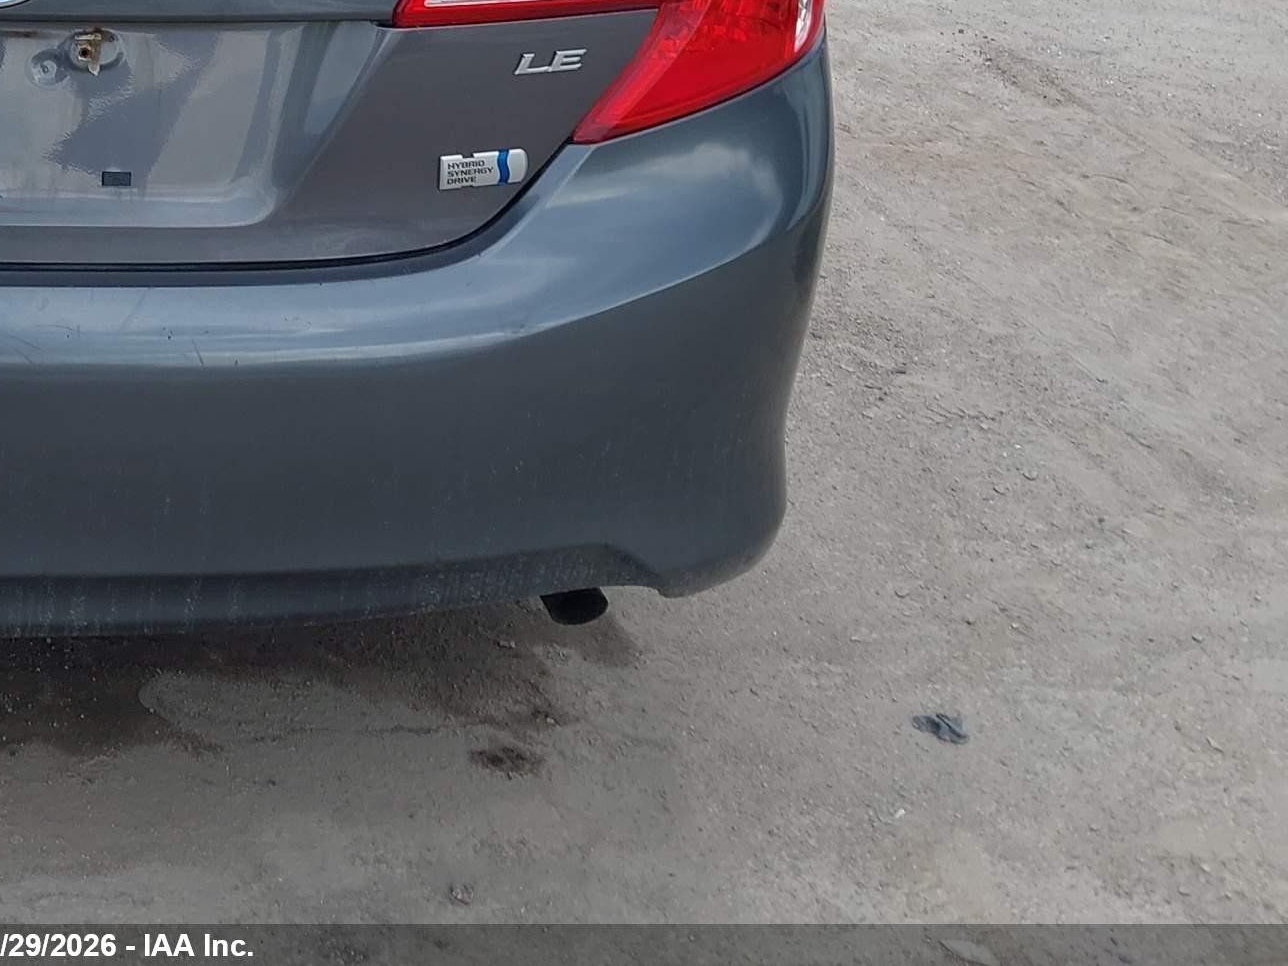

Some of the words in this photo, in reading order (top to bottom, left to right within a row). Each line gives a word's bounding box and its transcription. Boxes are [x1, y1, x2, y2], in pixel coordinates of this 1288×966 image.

[514, 48, 587, 76] LE
[447, 160, 485, 170] HYBRID
[447, 166, 494, 177] SYNERGY
[447, 176, 477, 185] DRIVE
